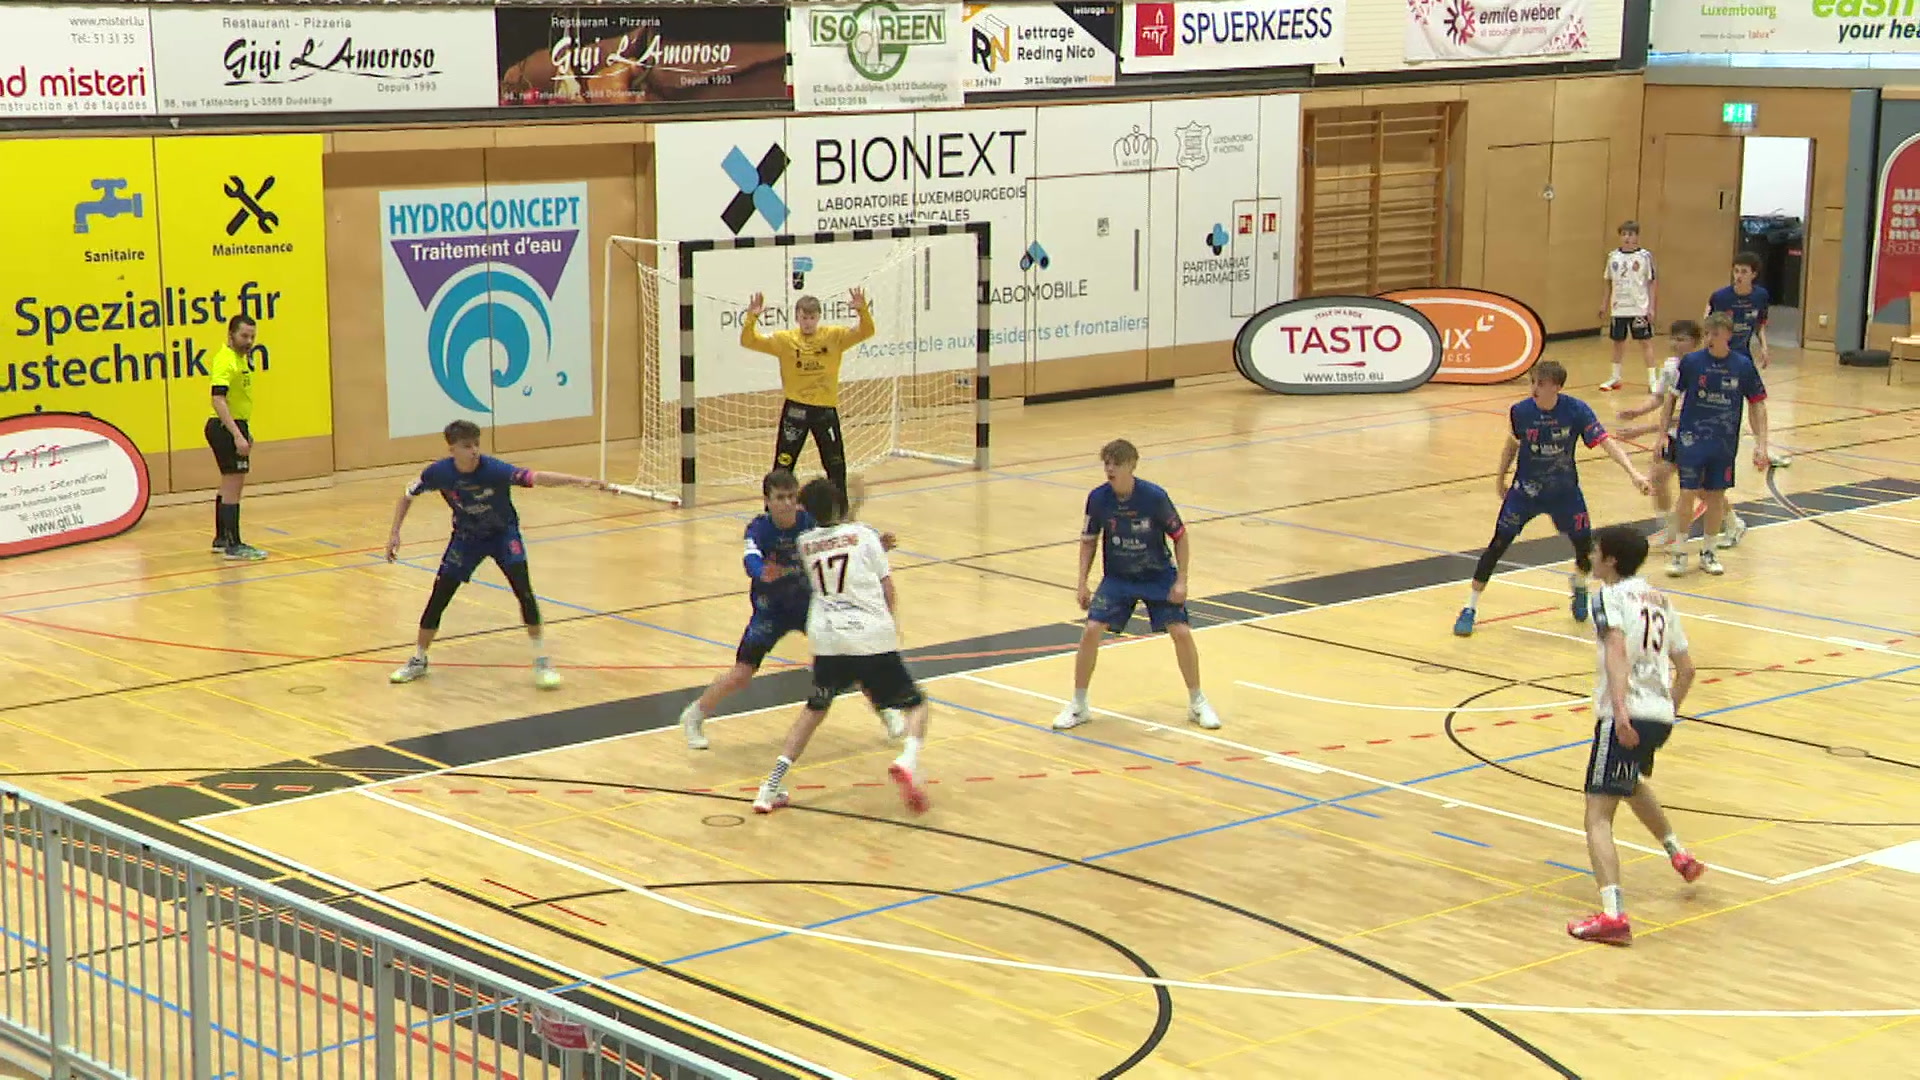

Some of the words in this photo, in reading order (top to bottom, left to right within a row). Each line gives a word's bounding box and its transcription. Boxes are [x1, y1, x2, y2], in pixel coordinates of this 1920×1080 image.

[1479, 7, 1518, 25] emile
[1520, 4, 1561, 22] weber
[1700, 3, 1777, 20] Luxembourg
[223, 17, 290, 29] Restaurant
[303, 16, 351, 29] Pizzeria
[552, 16, 608, 28] Restaurant
[619, 16, 661, 28] Pizzeria
[1181, 6, 1333, 45] SPUERKEESS
[93, 33, 105, 44] 51
[109, 33, 120, 44] 31
[123, 33, 135, 44] 35
[1017, 25, 1075, 42] Lettrage
[1838, 24, 1885, 44] your
[224, 37, 281, 79] Gigi
[552, 36, 600, 74] Gigi
[1017, 47, 1062, 62] Reding
[1066, 46, 1096, 60] Nico
[40, 67, 146, 97] misteri
[377, 82, 410, 94] Depuis
[413, 80, 437, 92] 1993
[680, 76, 709, 86] Depuis
[712, 74, 732, 85] 1993
[67, 101, 78, 111] et
[84, 101, 97, 111] de
[102, 100, 148, 113] façades
[816, 129, 1027, 187] BIONEXT
[816, 193, 909, 213] LABORATOIRE
[912, 185, 1027, 206] LUXEMBOURGEOIS
[389, 196, 580, 236] HYDROCONCEPT
[817, 211, 895, 232] D'ANALYSES
[84, 249, 146, 263] Sanitaire
[212, 241, 294, 257] Maintenance
[410, 239, 511, 262] Traitement
[514, 237, 562, 255] d'eau
[1183, 256, 1250, 274] PARTENARIAT
[1183, 269, 1251, 287] PHARMACIES
[15, 287, 227, 346] Spezialist
[947, 333, 976, 350] aux
[1055, 323, 1070, 339] et
[1074, 315, 1150, 337] frontaliers
[1280, 325, 1402, 354] TASTO
[1303, 372, 1384, 383] www.tasto.eu
[812, 553, 849, 596] 17
[1640, 607, 1665, 652] 13
